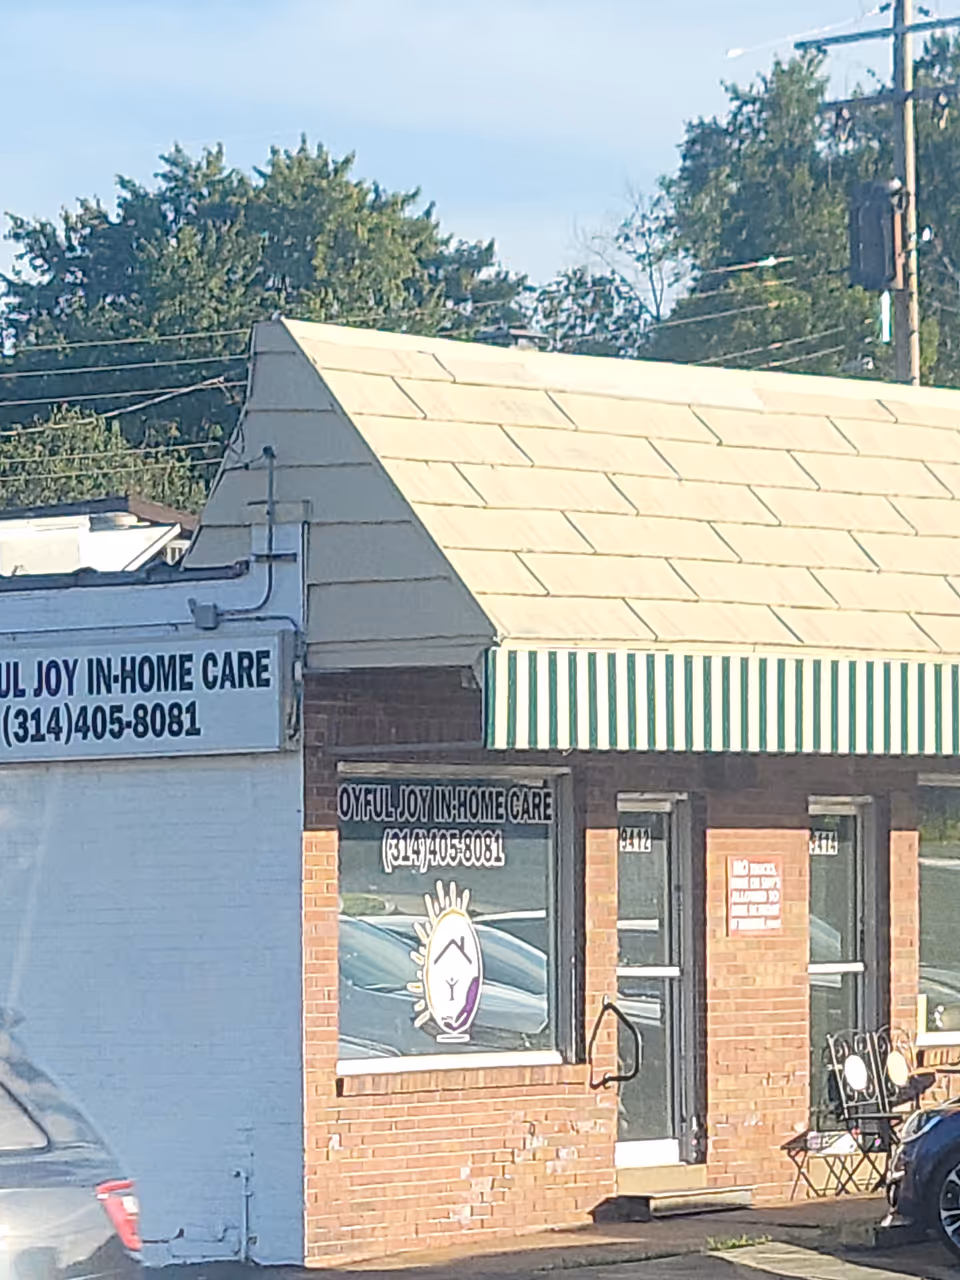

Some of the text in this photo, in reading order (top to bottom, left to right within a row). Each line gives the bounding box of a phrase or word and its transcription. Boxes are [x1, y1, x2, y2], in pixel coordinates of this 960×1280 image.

[33, 658, 79, 698] JOY
[87, 653, 194, 695] IN-HOME
[201, 650, 272, 690] CARE
[2, 701, 202, 747] (314)405-8081
[338, 784, 396, 822] OYFUL
[396, 785, 432, 822] JOY
[507, 787, 554, 824] CARE
[382, 828, 506, 873] (314)405-8081
